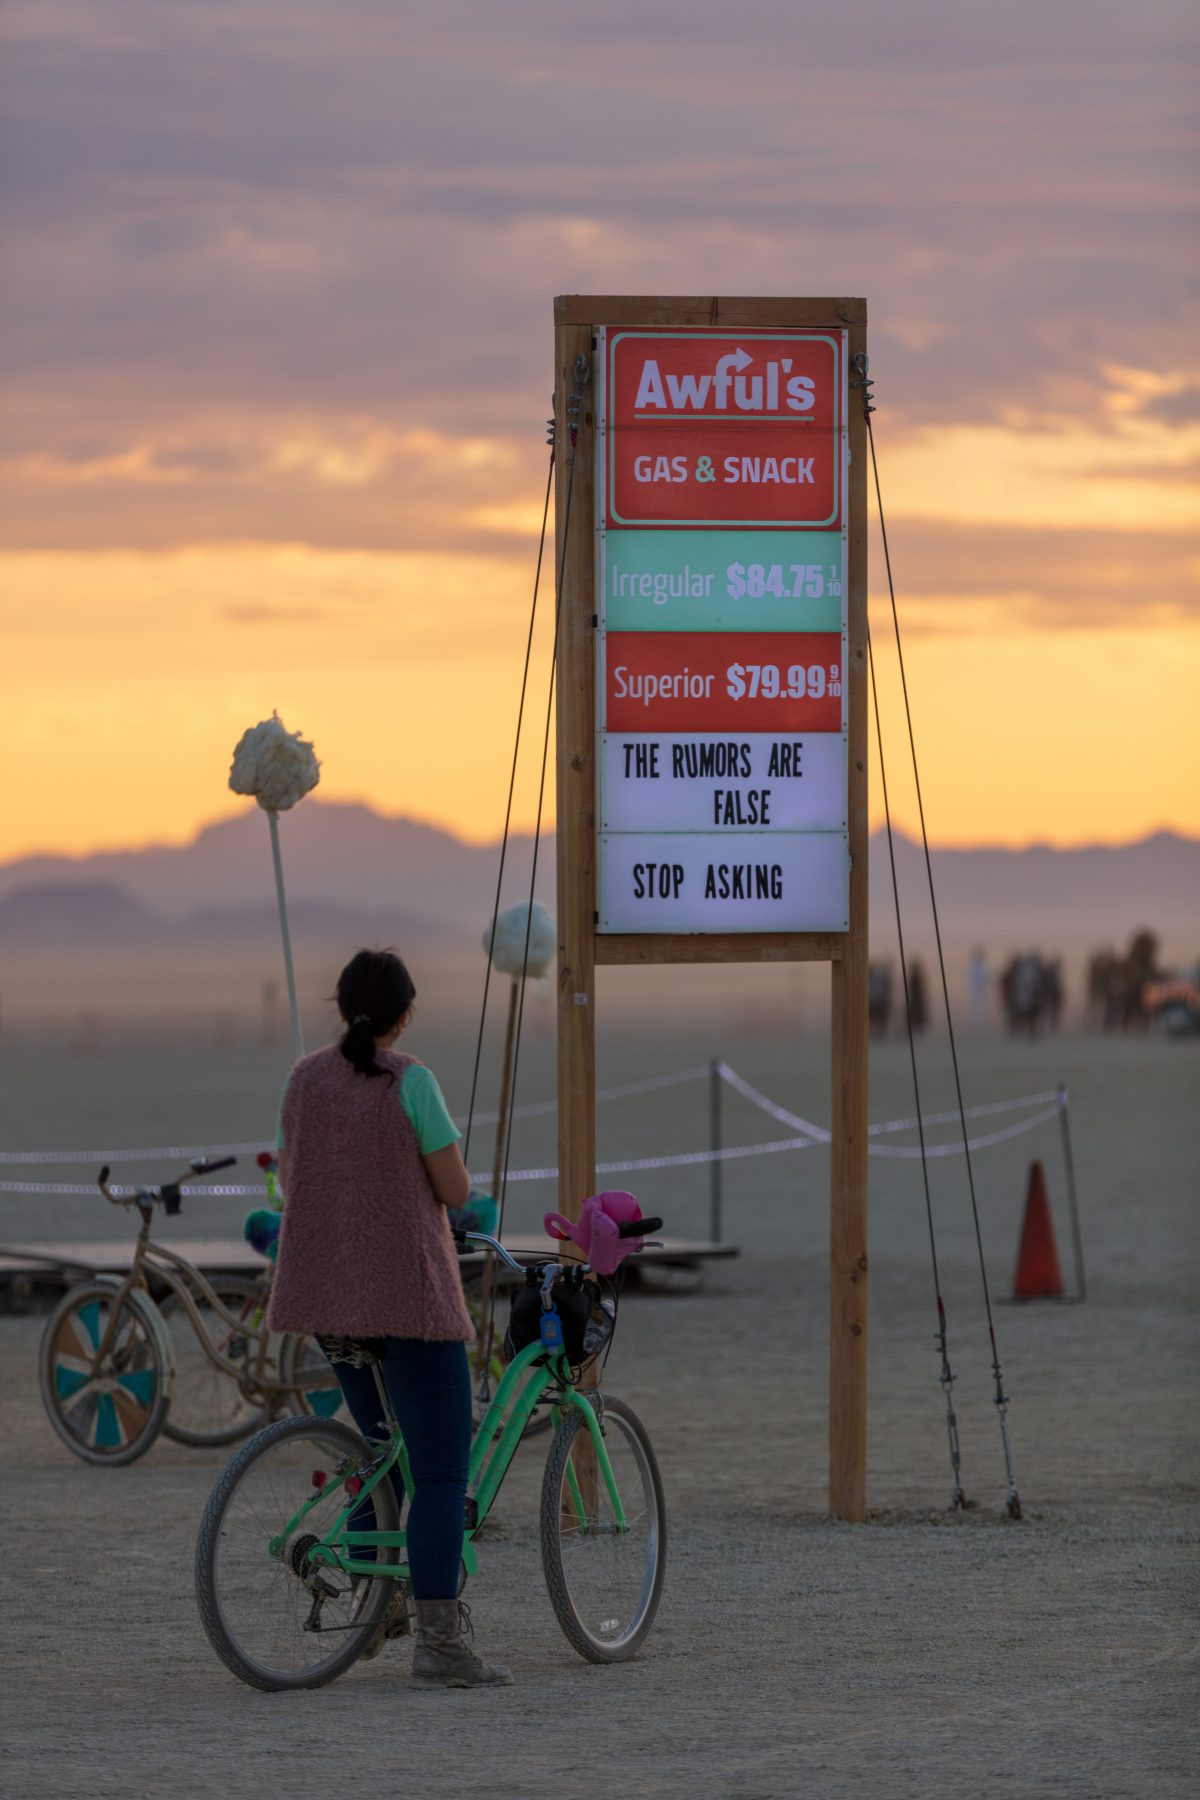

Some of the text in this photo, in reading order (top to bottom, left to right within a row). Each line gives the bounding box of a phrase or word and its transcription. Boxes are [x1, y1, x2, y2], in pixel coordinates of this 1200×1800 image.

[634, 347, 815, 411] Awful's
[634, 455, 815, 484] GAS & SNACK
[612, 561, 824, 605] Irregular $84.75
[614, 662, 826, 706] Superior $79.99
[623, 742, 803, 778] THE RUMORS ARE
[713, 789, 771, 825] FALSE
[633, 863, 783, 900] STOP ASKING
